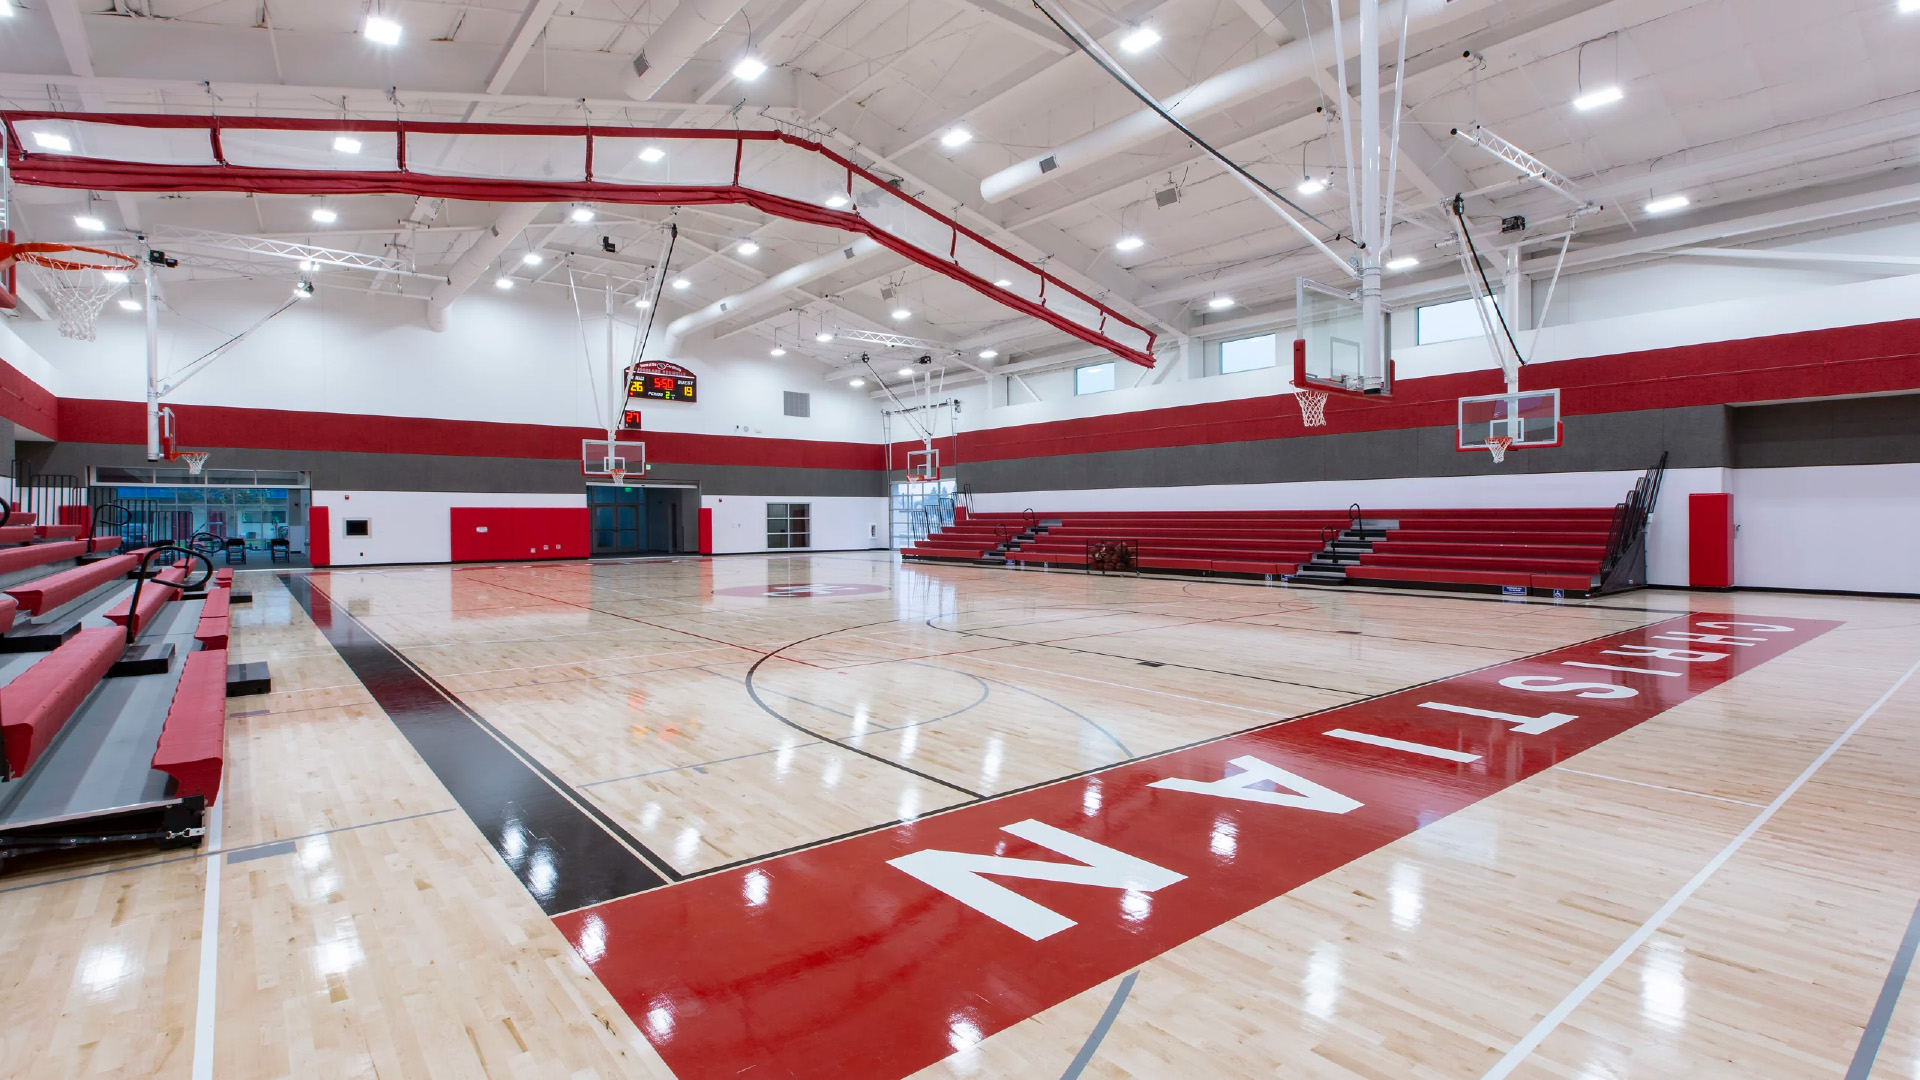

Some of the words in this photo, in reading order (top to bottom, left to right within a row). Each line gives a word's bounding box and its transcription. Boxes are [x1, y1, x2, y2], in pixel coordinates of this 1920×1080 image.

[631, 382, 643, 392] 26
[654, 378, 674, 388] 5:50
[684, 386, 692, 396] 19
[627, 412, 639, 423] 27
[886, 621, 1795, 941] CHRISTIAN
